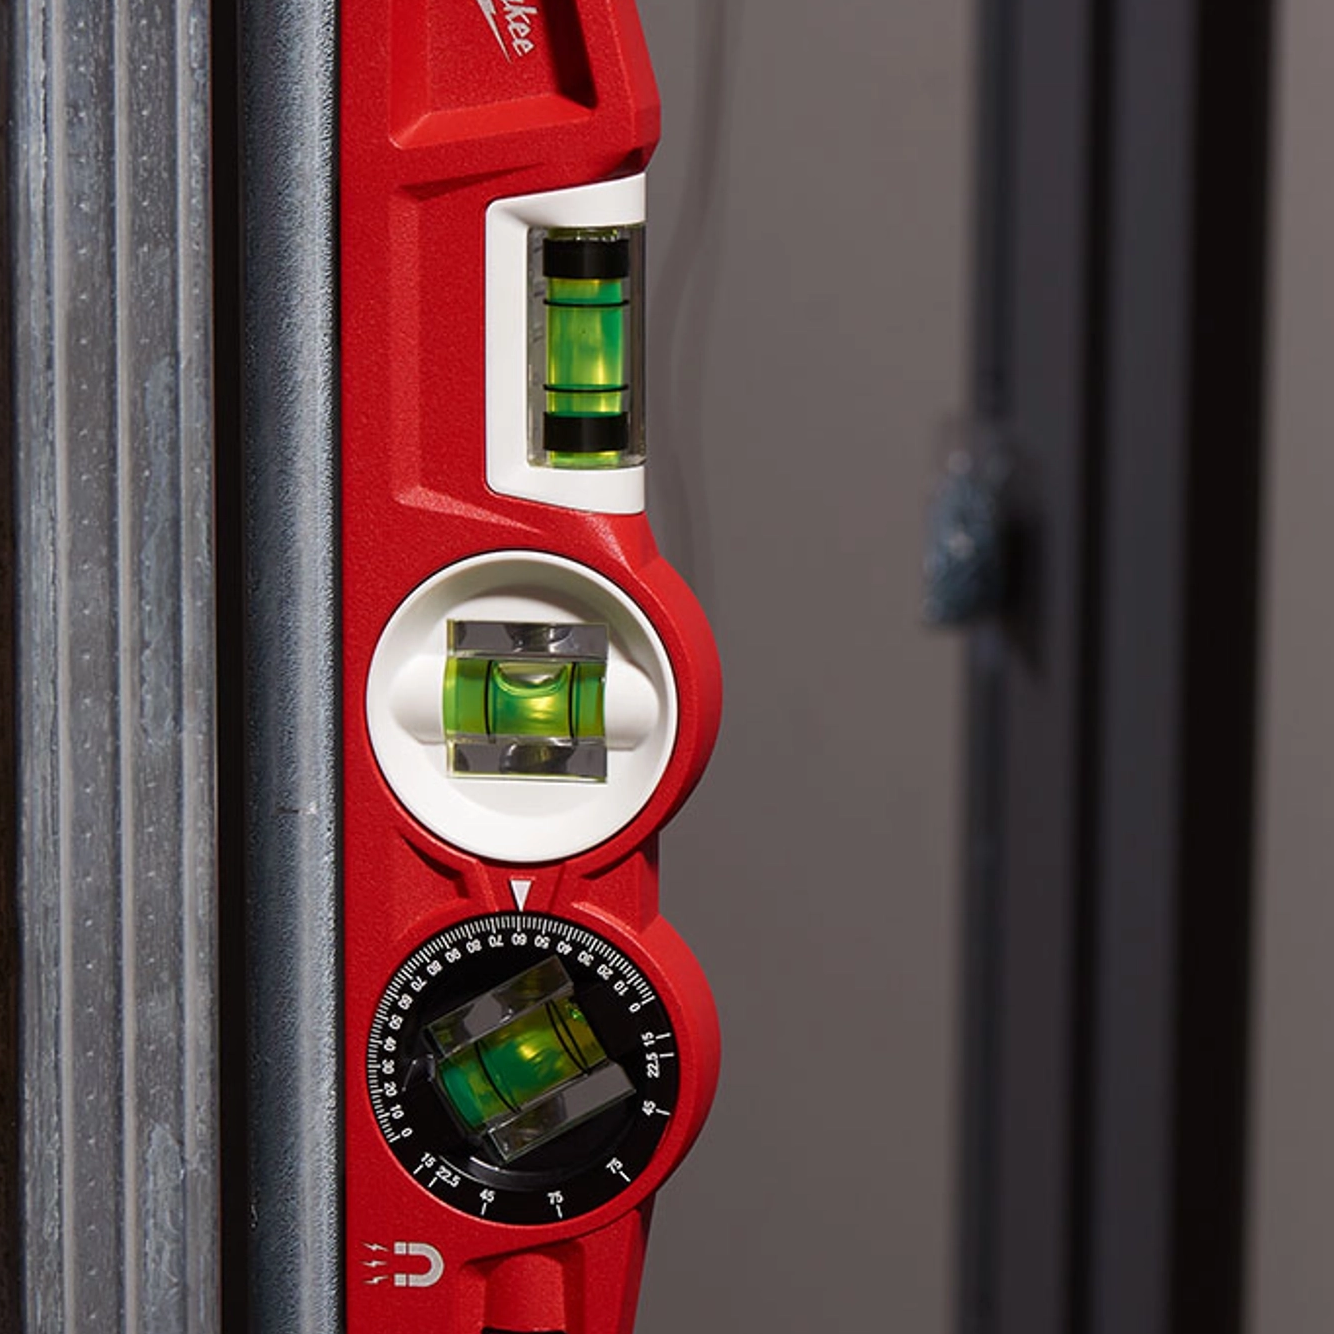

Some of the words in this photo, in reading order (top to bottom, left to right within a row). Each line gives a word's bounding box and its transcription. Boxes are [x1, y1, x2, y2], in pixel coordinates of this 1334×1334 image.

[466, 939, 482, 953] 80
[488, 935, 504, 947] 70
[511, 933, 527, 945] 60
[534, 935, 550, 949] 50
[556, 941, 572, 955] 40
[577, 950, 594, 966] 30
[427, 960, 443, 976] 80
[597, 964, 613, 980] 20
[410, 976, 427, 992] 70
[613, 980, 630, 996] 10
[398, 994, 413, 1010] 60
[629, 1002, 642, 1013] 0
[388, 1014, 403, 1030] 50
[384, 1036, 396, 1052] 40
[641, 1032, 655, 1047] 15
[382, 1059, 394, 1074] 30
[646, 1052, 659, 1078] 22.5
[384, 1081, 398, 1097] 20
[390, 1104, 404, 1119] 10
[642, 1101, 656, 1116] 45
[401, 1128, 413, 1137] 0
[420, 1152, 436, 1169] 15
[606, 1158, 624, 1175] 75
[436, 1166, 461, 1187] 22.5
[480, 1189, 495, 1203] 45
[548, 1191, 563, 1204] 75
